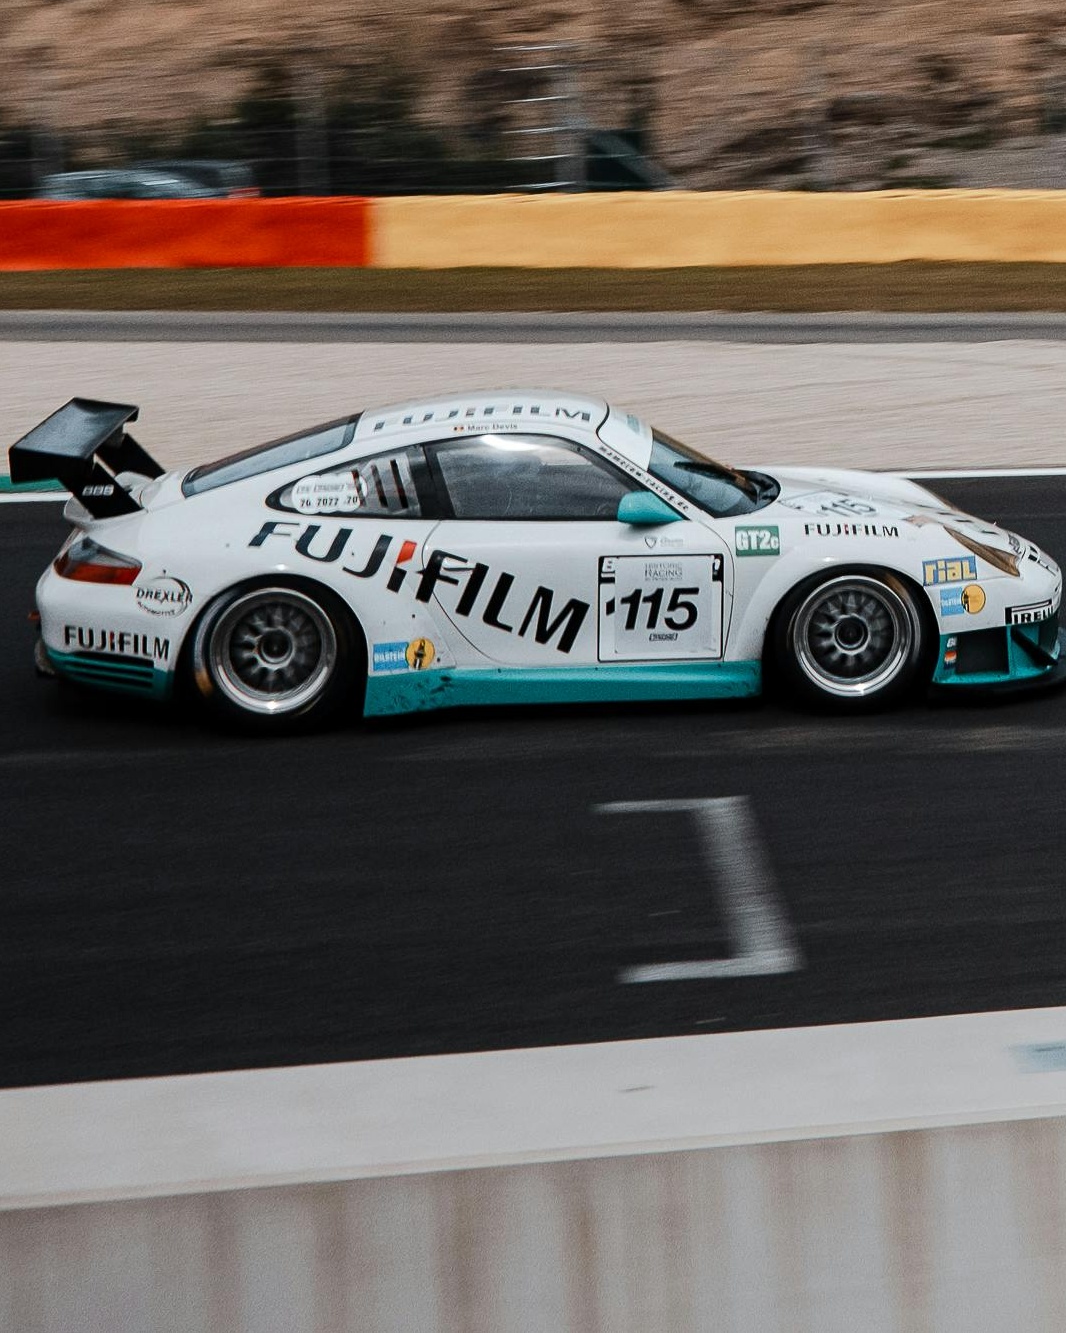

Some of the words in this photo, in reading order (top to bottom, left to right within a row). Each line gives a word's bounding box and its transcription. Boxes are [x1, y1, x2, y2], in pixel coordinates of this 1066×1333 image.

[374, 407, 590, 433] FUJIFILM
[804, 523, 899, 537] FUJIFILM
[645, 569, 682, 578] RACING
[136, 587, 193, 603] DREXLER
[248, 521, 590, 654] FUJIFILM
[620, 587, 699, 631] 115
[64, 624, 170, 661] FUJIFILM
